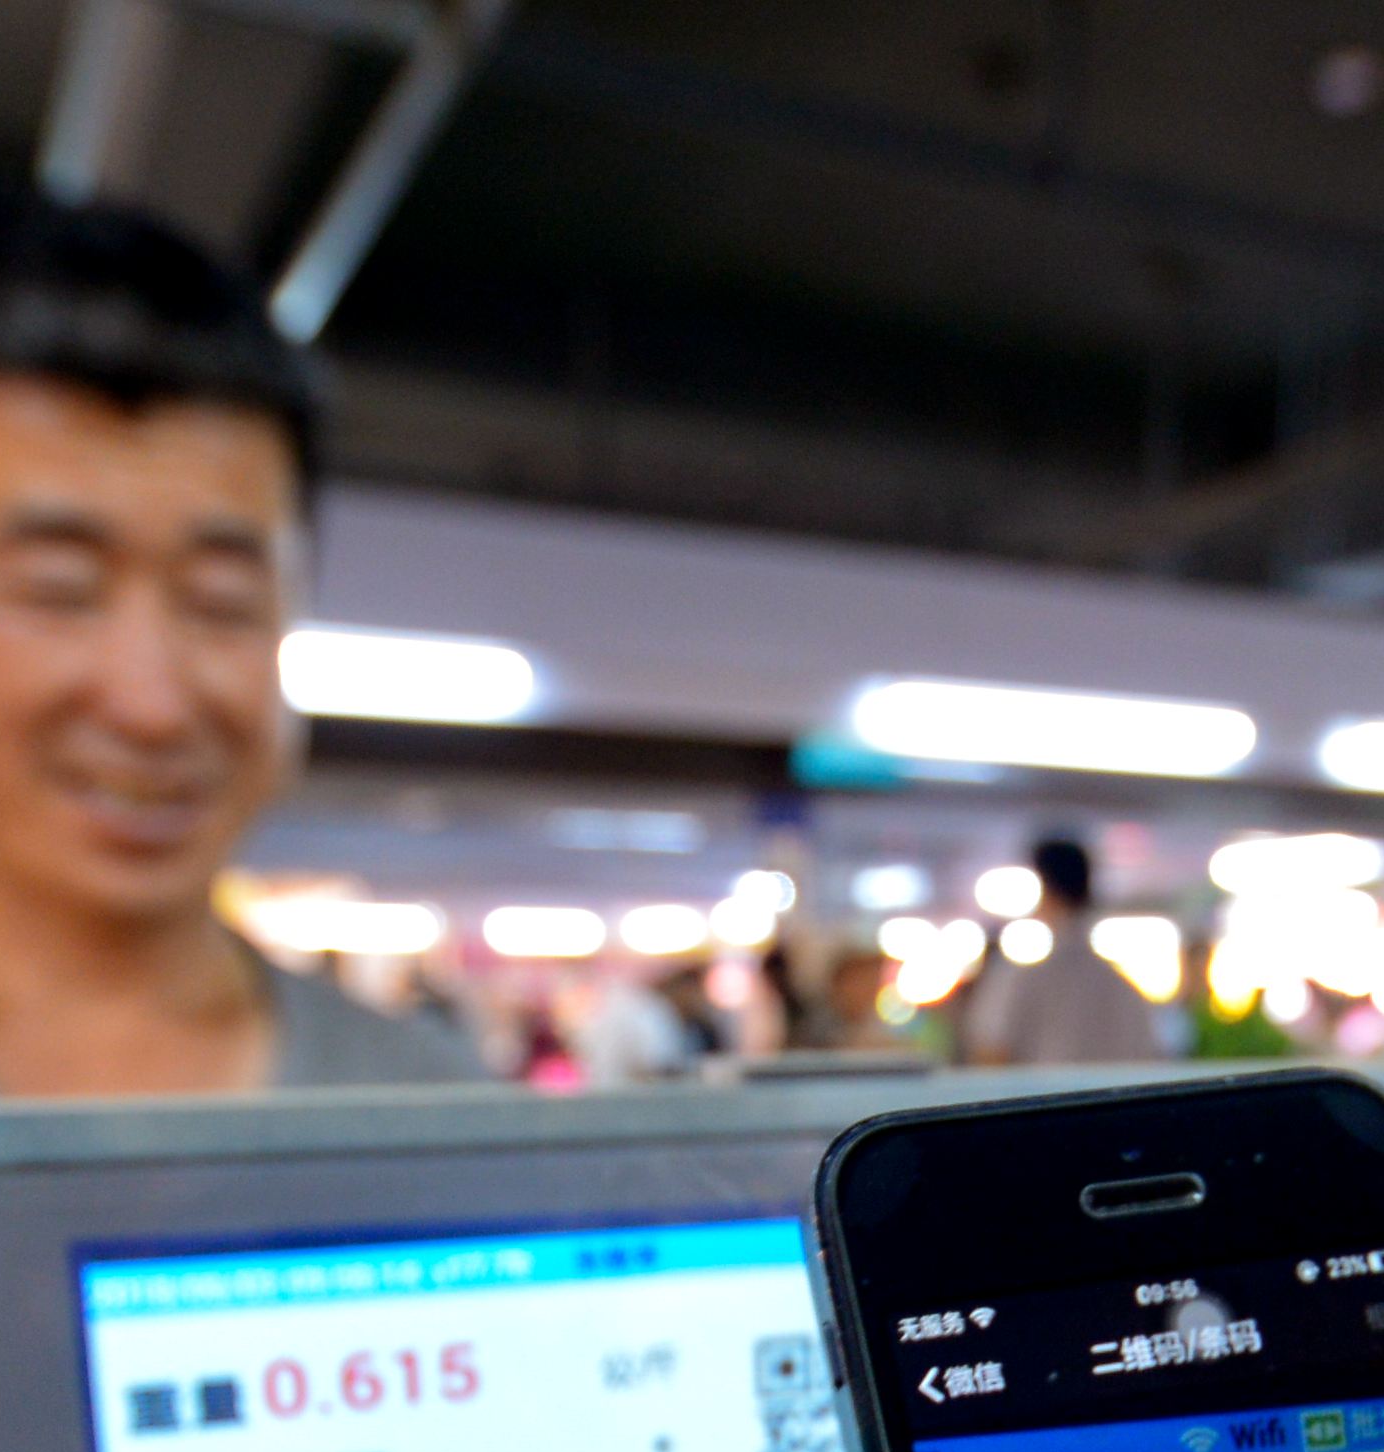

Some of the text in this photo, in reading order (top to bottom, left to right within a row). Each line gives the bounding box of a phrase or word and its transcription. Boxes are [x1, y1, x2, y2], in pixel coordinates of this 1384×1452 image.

[1326, 1253, 1368, 1279] 23%
[1136, 1279, 1198, 1305] 09:56
[898, 1311, 965, 1342] 无服务
[1091, 1319, 1263, 1375] 二维码/条码
[262, 1341, 480, 1418] 0.615
[943, 1361, 1006, 1398] 微信
[1230, 1416, 1286, 1450] Wifi
